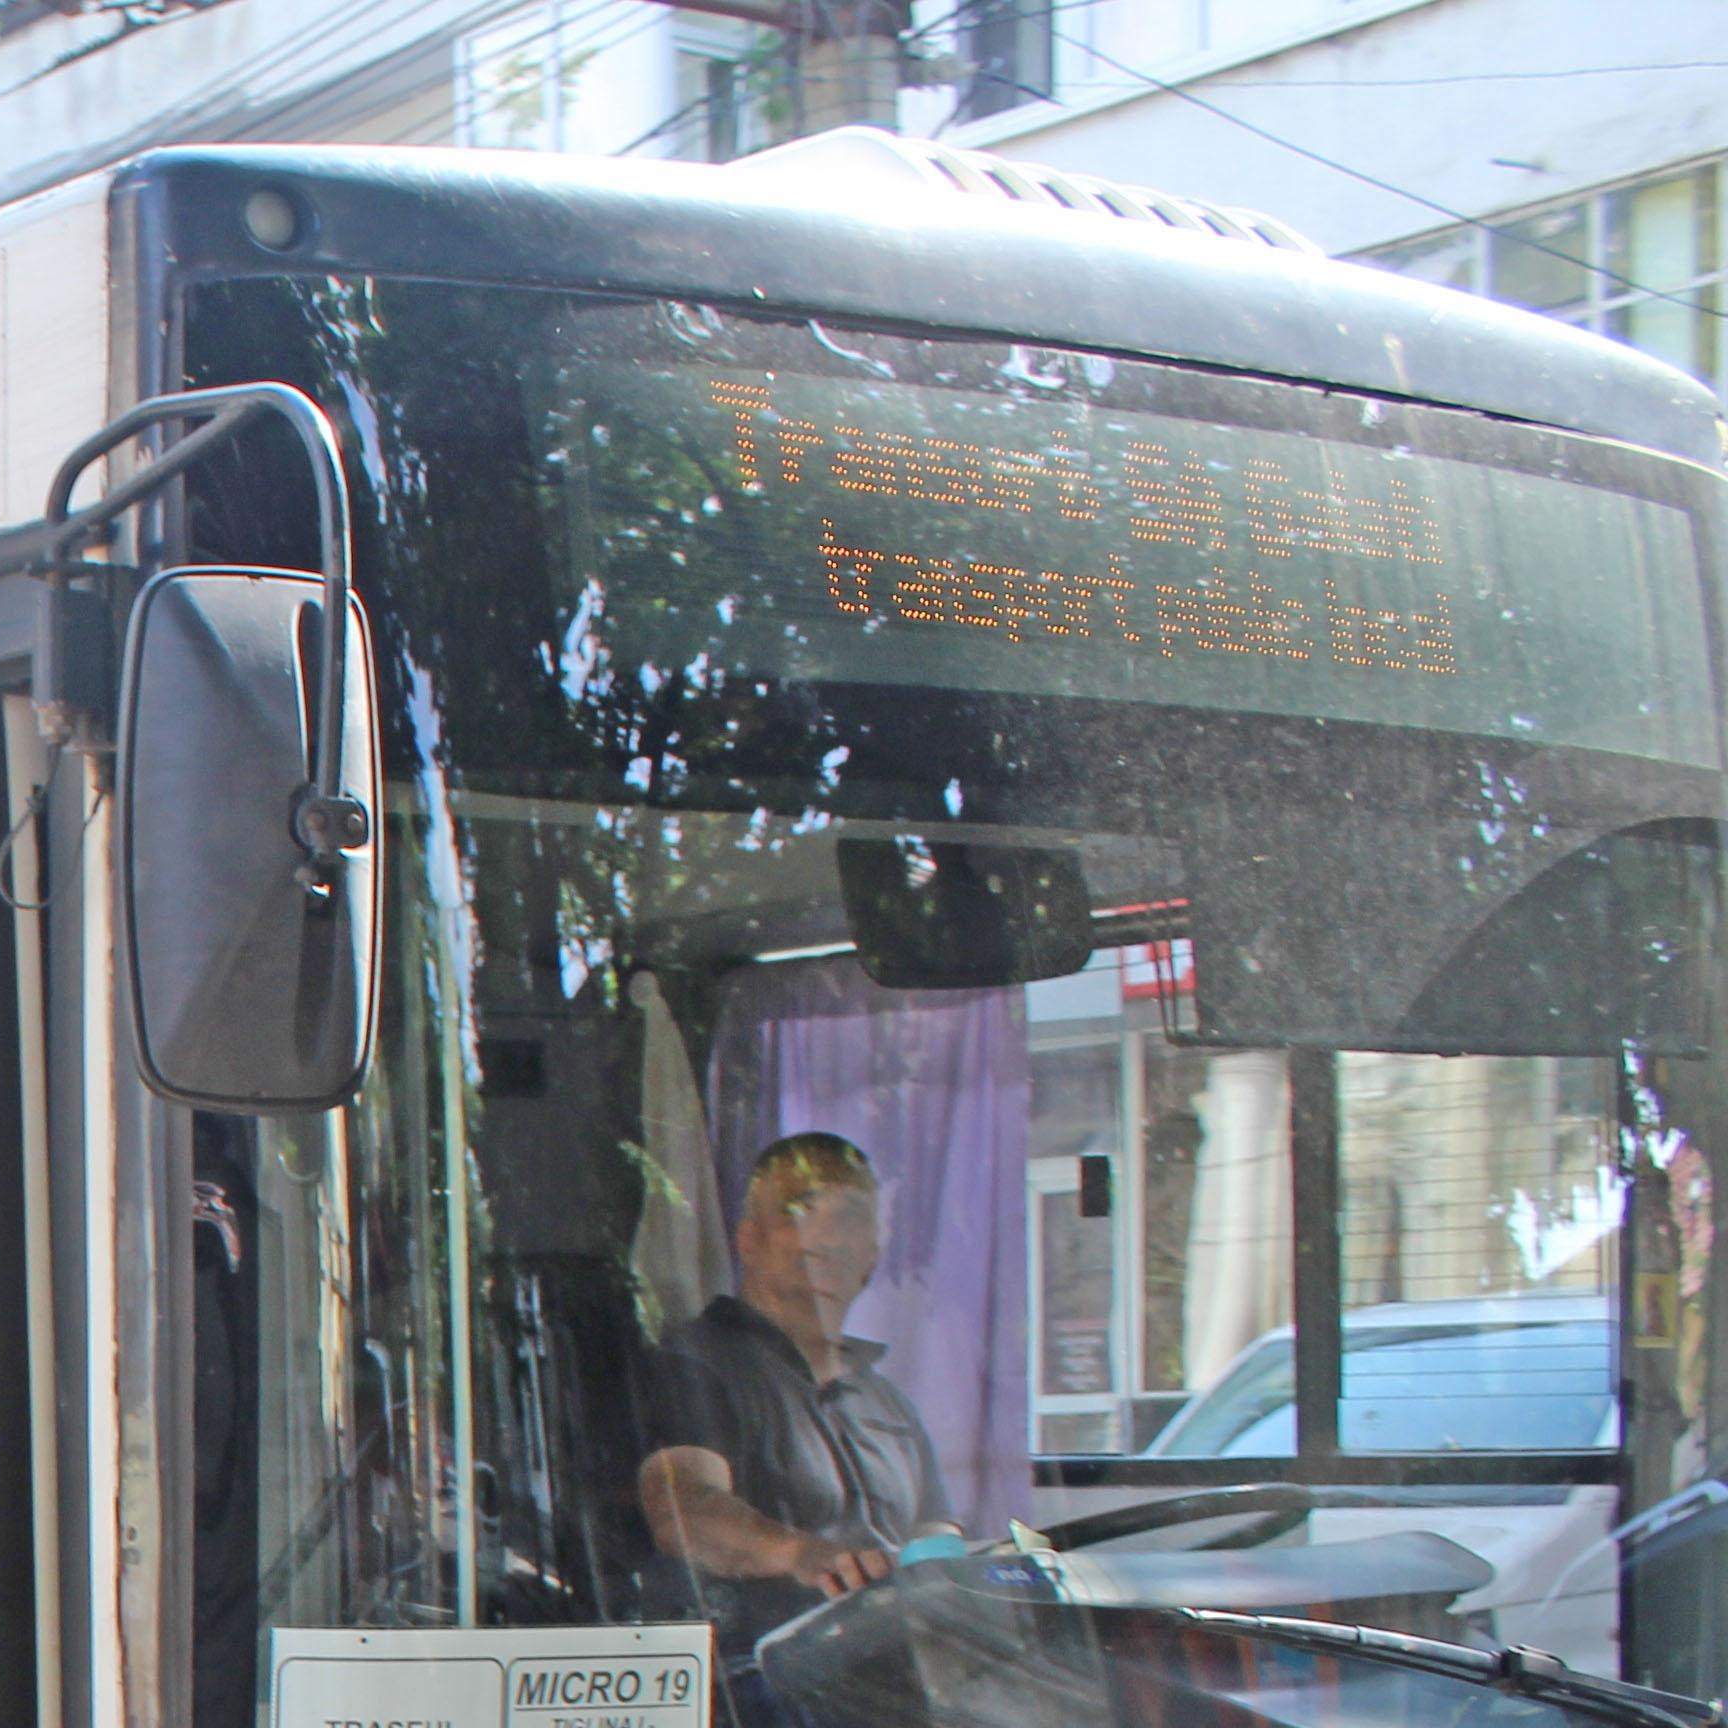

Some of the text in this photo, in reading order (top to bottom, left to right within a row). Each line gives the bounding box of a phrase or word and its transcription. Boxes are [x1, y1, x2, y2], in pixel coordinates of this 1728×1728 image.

[1121, 441, 1228, 551] SA
[515, 1668, 691, 1706] MICRO 19
